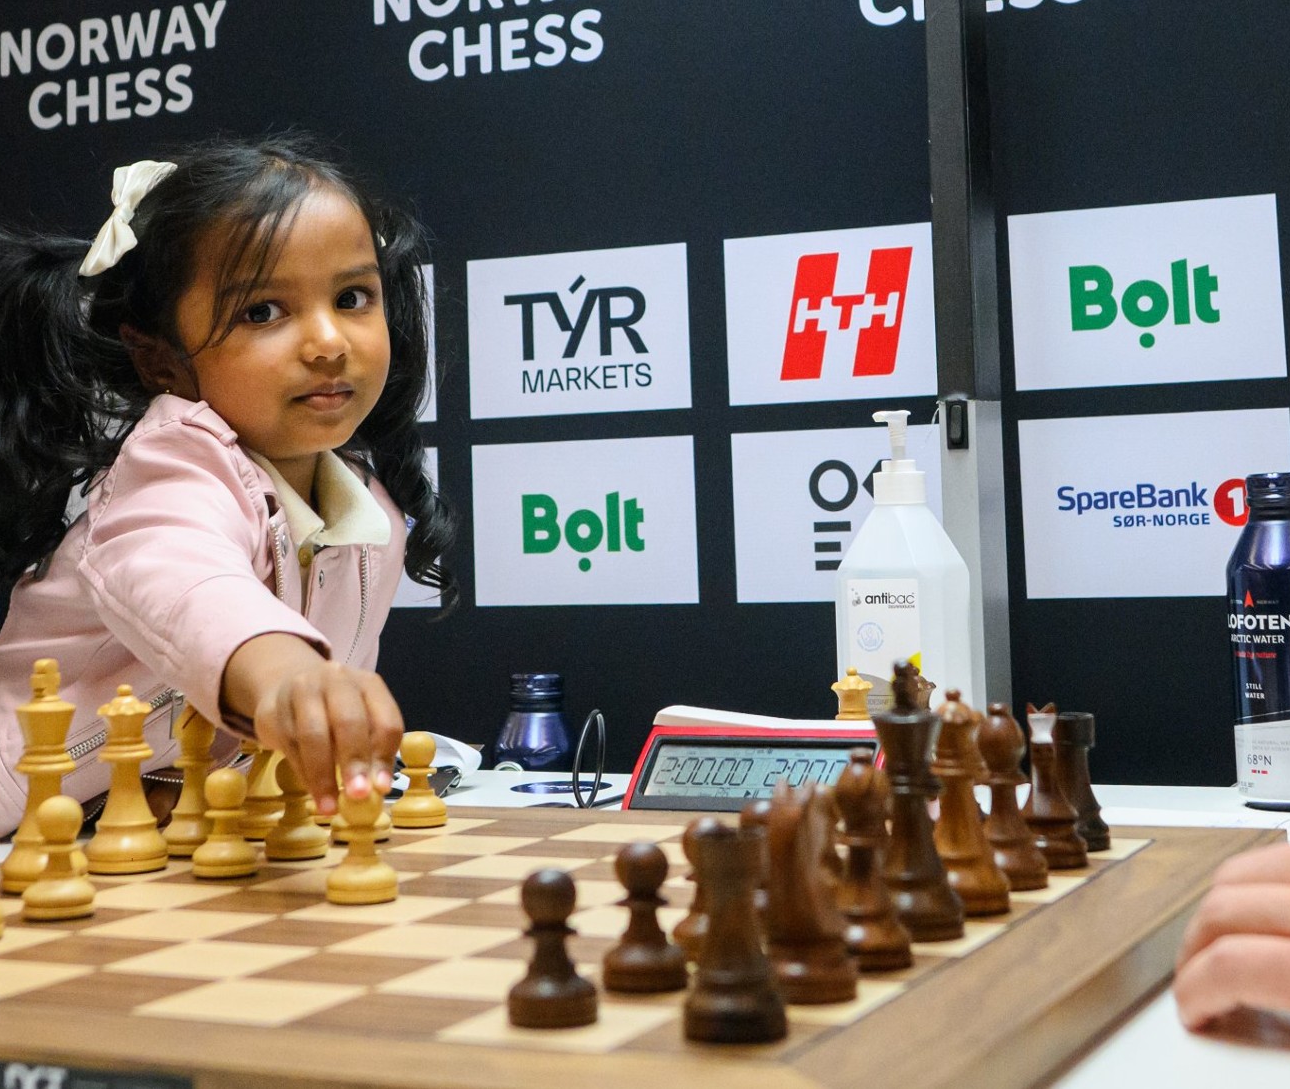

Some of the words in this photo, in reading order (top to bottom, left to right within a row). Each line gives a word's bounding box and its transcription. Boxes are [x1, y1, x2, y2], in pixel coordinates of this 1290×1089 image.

[1, 0, 226, 82] NORWAY
[409, 9, 603, 81] CHESS
[29, 64, 193, 129] CHESS
[1069, 259, 1220, 348] Bolt
[523, 363, 652, 393] MARKETS
[1057, 482, 1208, 515] SpareBank
[522, 492, 644, 572] Bolt
[1113, 513, 1210, 527] SØR-NORGE
[864, 592, 916, 605] antibac
[1252, 634, 1286, 644] WATER
[1244, 692, 1265, 700] WATER
[1245, 682, 1263, 690] STILL
